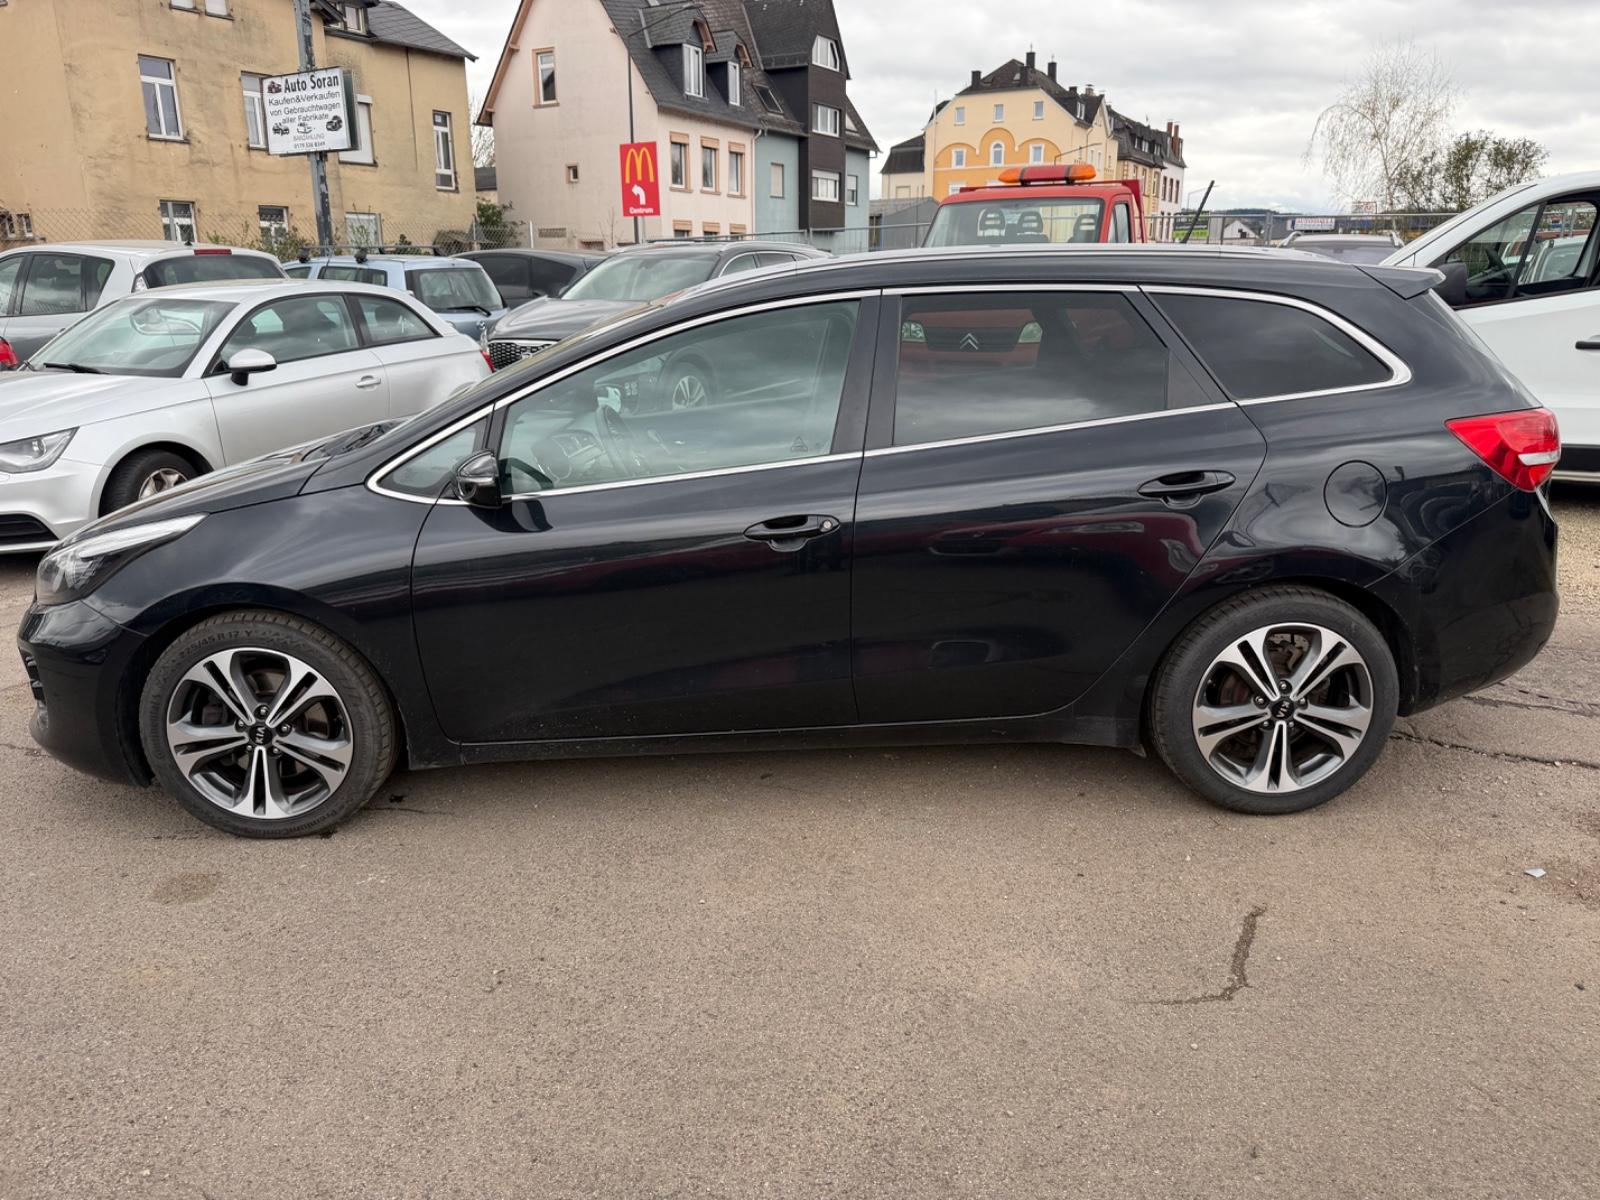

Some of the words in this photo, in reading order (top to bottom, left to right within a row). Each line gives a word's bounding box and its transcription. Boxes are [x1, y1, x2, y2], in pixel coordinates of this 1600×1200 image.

[284, 78, 307, 93] Auto
[310, 75, 339, 90] Soran
[268, 91, 340, 106] Kaufen&Verkaufen
[270, 109, 281, 117] von
[284, 102, 340, 115] Gebrauchtwagen
[282, 116, 296, 124] aller
[298, 113, 329, 122] Fabrikate
[629, 206, 654, 214] Centrum
